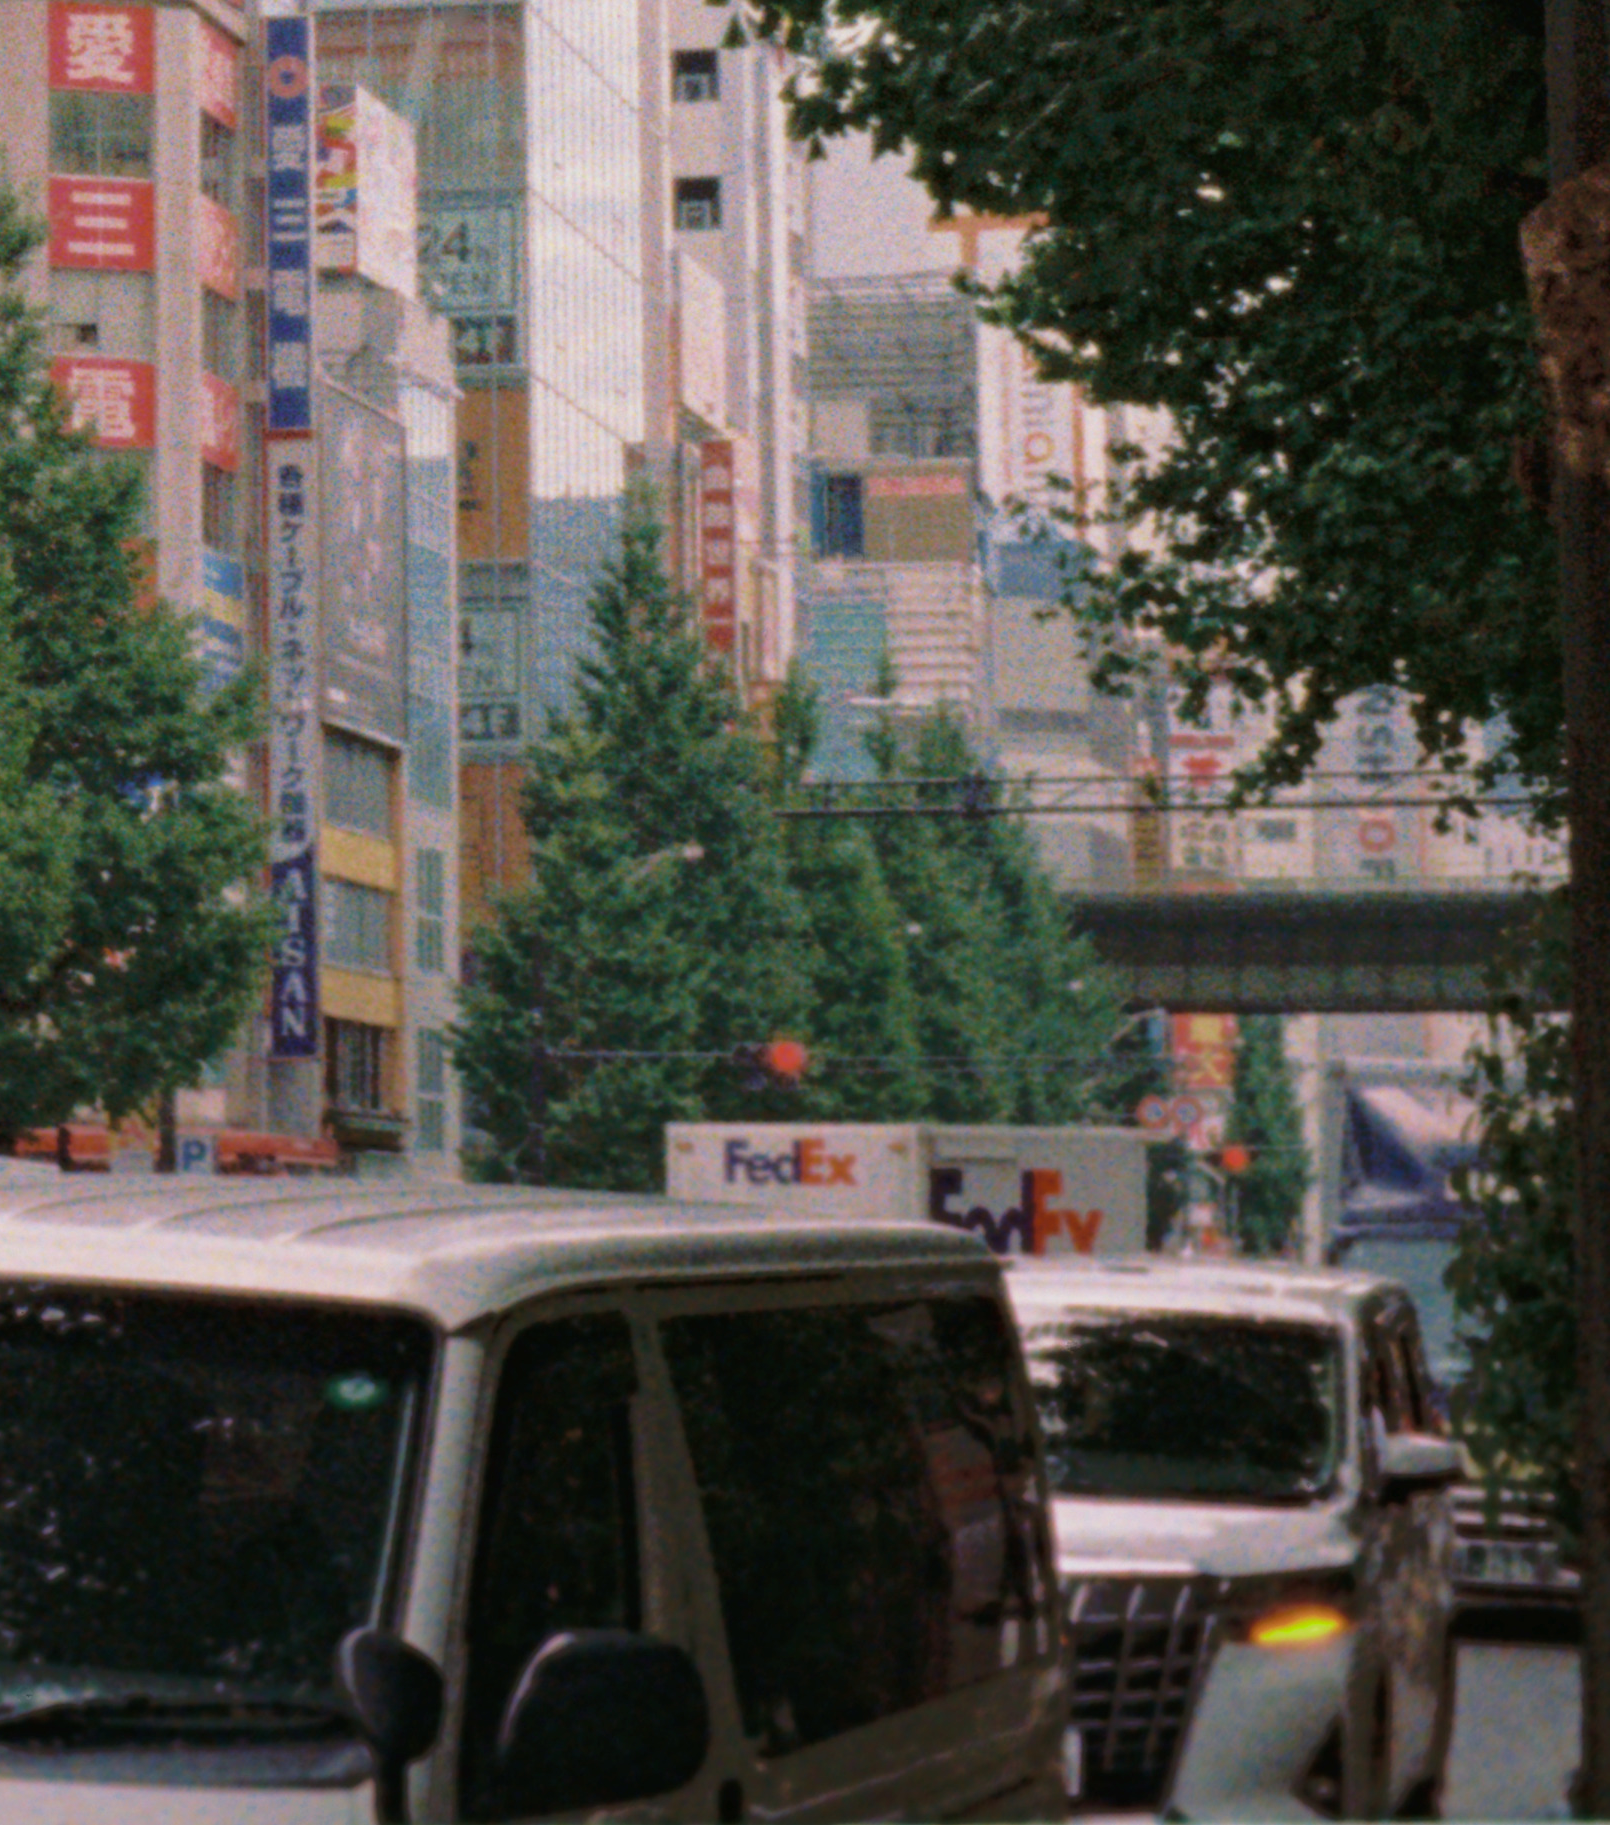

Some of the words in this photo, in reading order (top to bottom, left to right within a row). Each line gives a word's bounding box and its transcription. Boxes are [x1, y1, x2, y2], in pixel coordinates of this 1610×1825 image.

[66, 11, 136, 86] 愛
[68, 190, 136, 257] 三
[280, 868, 307, 1038] AISAN
[182, 1139, 206, 1165] P
[723, 1138, 858, 1187] FedEx
